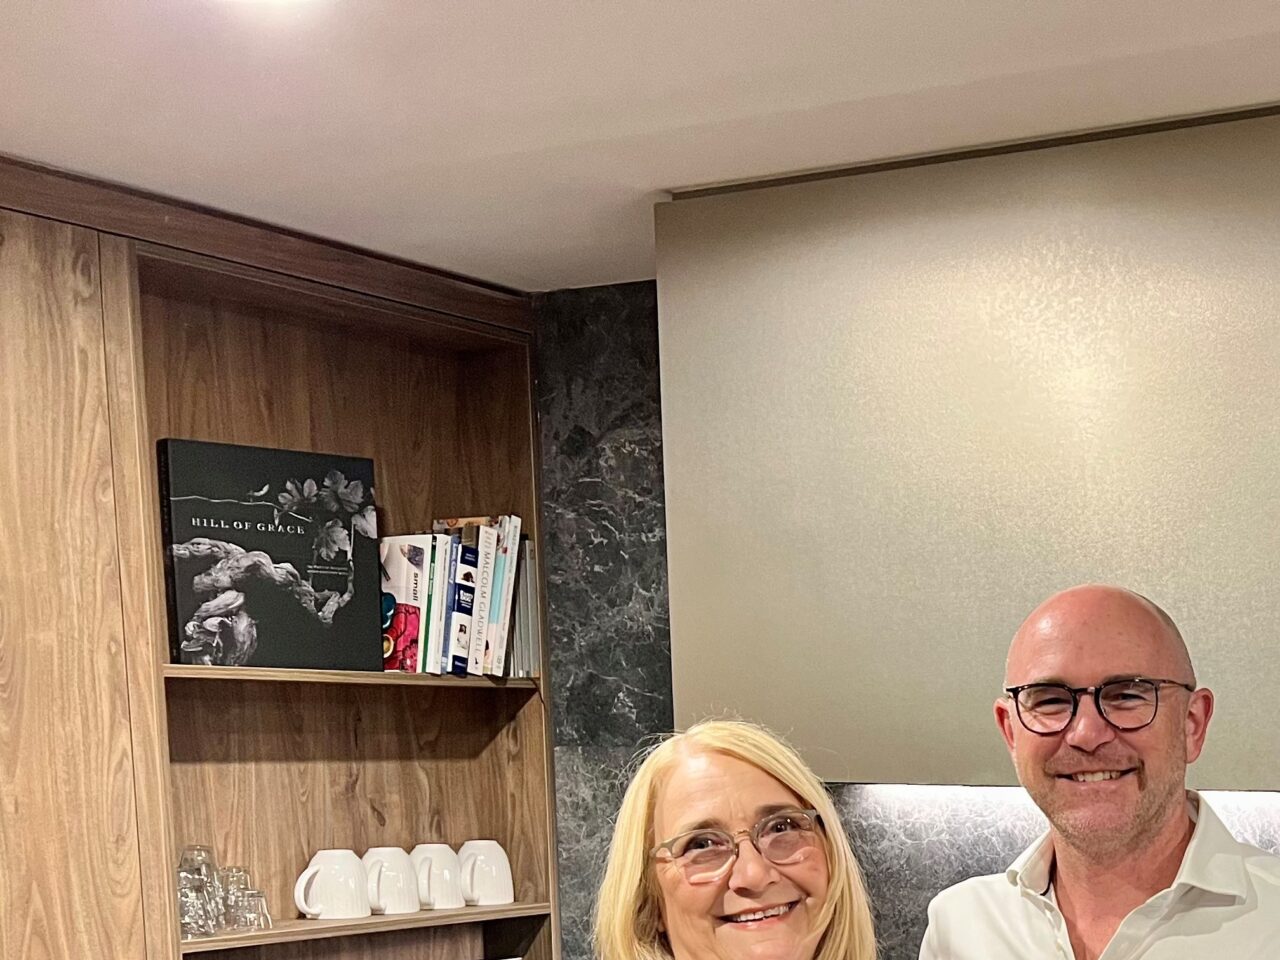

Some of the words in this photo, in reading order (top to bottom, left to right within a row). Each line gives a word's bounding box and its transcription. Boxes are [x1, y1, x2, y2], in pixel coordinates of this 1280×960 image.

[191, 517, 229, 529] HILL
[233, 521, 252, 530] OF
[256, 522, 305, 534] GRACE
[480, 551, 491, 599] MALCOLM
[475, 602, 487, 654] GLADWELL
